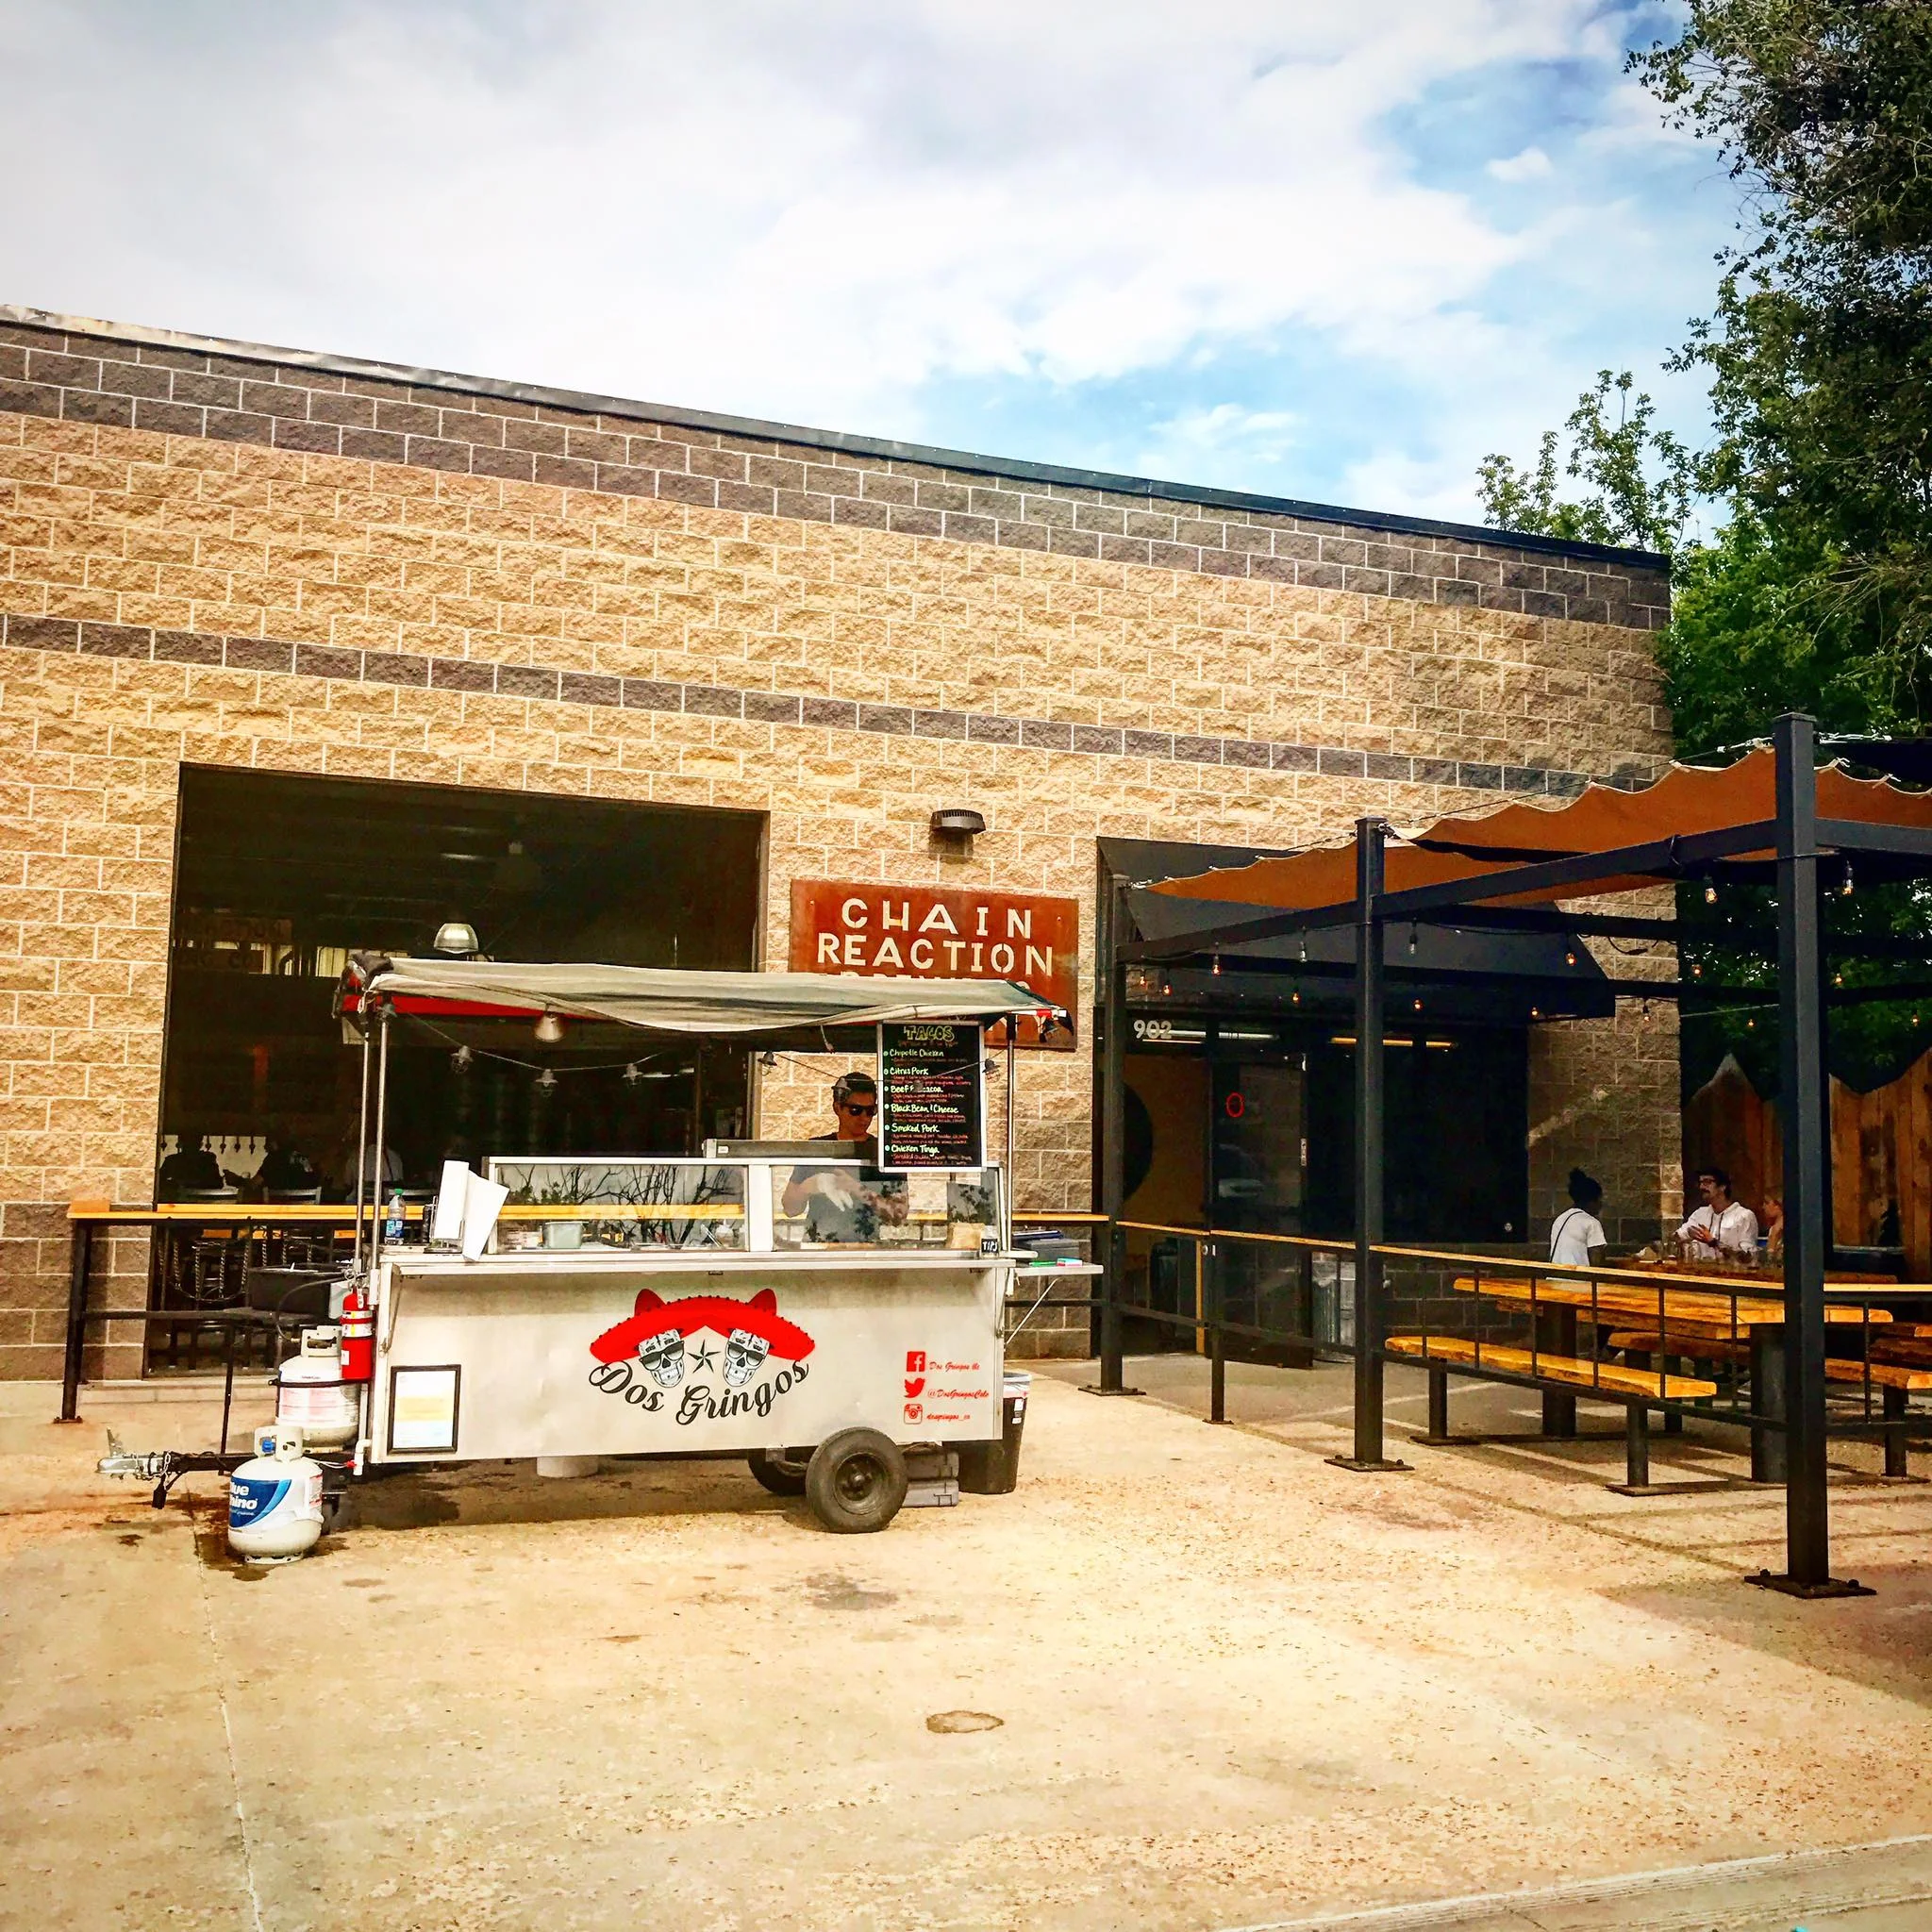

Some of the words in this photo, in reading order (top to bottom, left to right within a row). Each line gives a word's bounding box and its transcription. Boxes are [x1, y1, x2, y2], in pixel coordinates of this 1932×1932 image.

[841, 898, 1032, 940] CHAIN
[817, 932, 1053, 976] REACTION
[903, 1025, 955, 1041] TACOS
[1133, 1020, 1172, 1039] 902
[890, 1049, 918, 1058] Chipotle
[891, 1103, 911, 1112] Black
[911, 1104, 929, 1112] Bean
[933, 1105, 959, 1113] Cheese
[891, 1123, 920, 1132] Smoked
[921, 1124, 940, 1132] Pork
[891, 1144, 919, 1153] Chicken
[920, 1144, 940, 1157] Tinga
[982, 1241, 997, 1251] TIPS
[589, 1360, 664, 1411] Dos
[675, 1360, 809, 1424] Gringos
[229, 1482, 250, 1496] lue
[229, 1494, 258, 1510] hino
